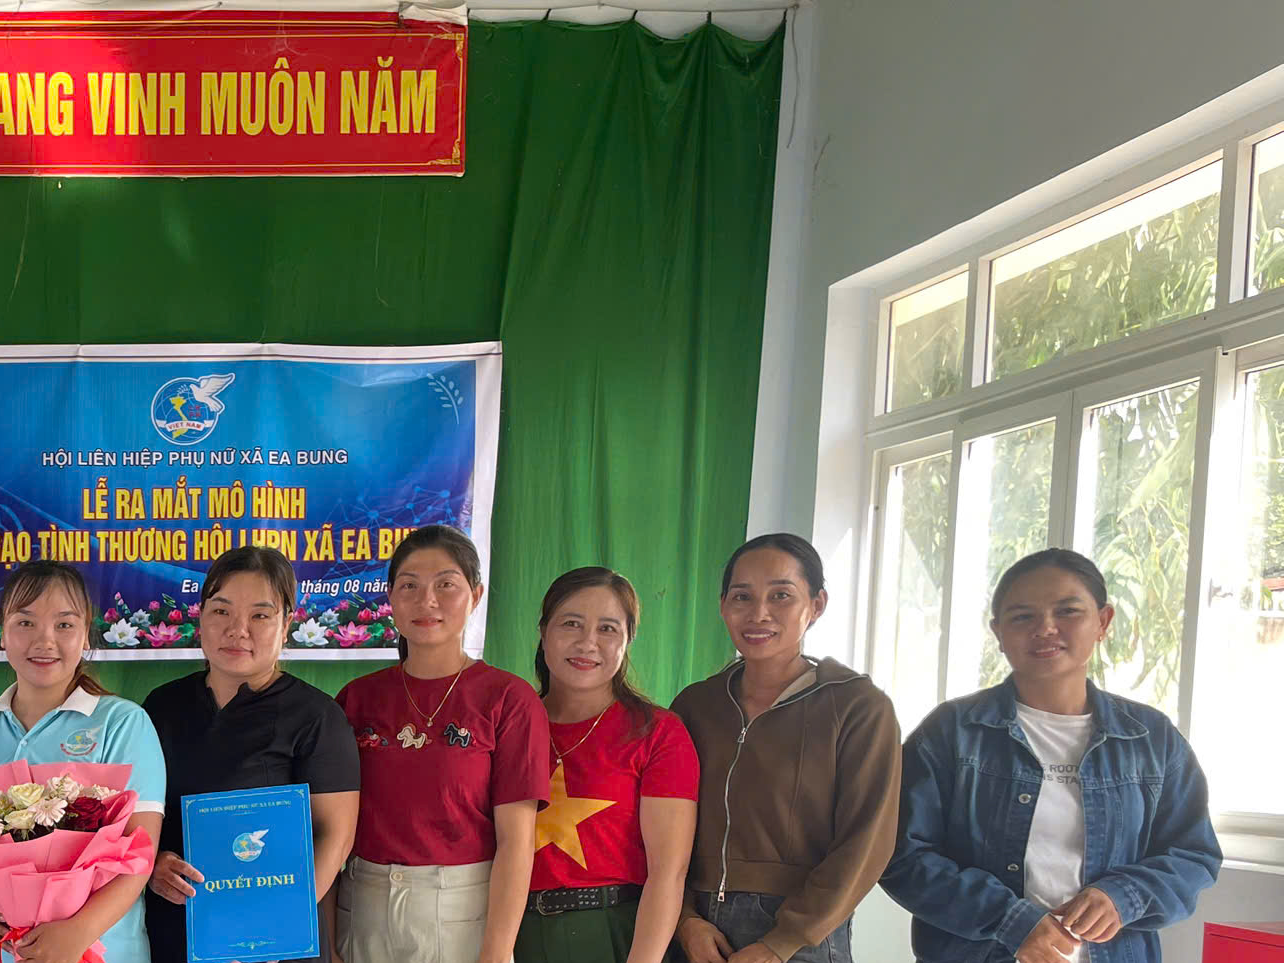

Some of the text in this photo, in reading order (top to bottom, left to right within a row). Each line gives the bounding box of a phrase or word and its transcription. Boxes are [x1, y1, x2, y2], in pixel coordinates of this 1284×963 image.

[87, 71, 185, 136] VINH
[201, 57, 327, 135] MUÔN
[340, 56, 437, 134] NĂM
[42, 447, 348, 469] HỘI LIÊN HIỆP PHỤ NỮ XÃ EA BUNG
[82, 475, 307, 520] LỄ RA MẮT MÔ HÌNH
[37, 525, 91, 563] TÌNH
[95, 526, 188, 562] THƯƠNG
[302, 523, 335, 561] XÃ
[341, 528, 372, 561] EA
[181, 579, 199, 594] Ea
[301, 578, 340, 597] tháng
[343, 579, 361, 593] 08
[204, 874, 295, 893] QUYẾT ĐỊNH
